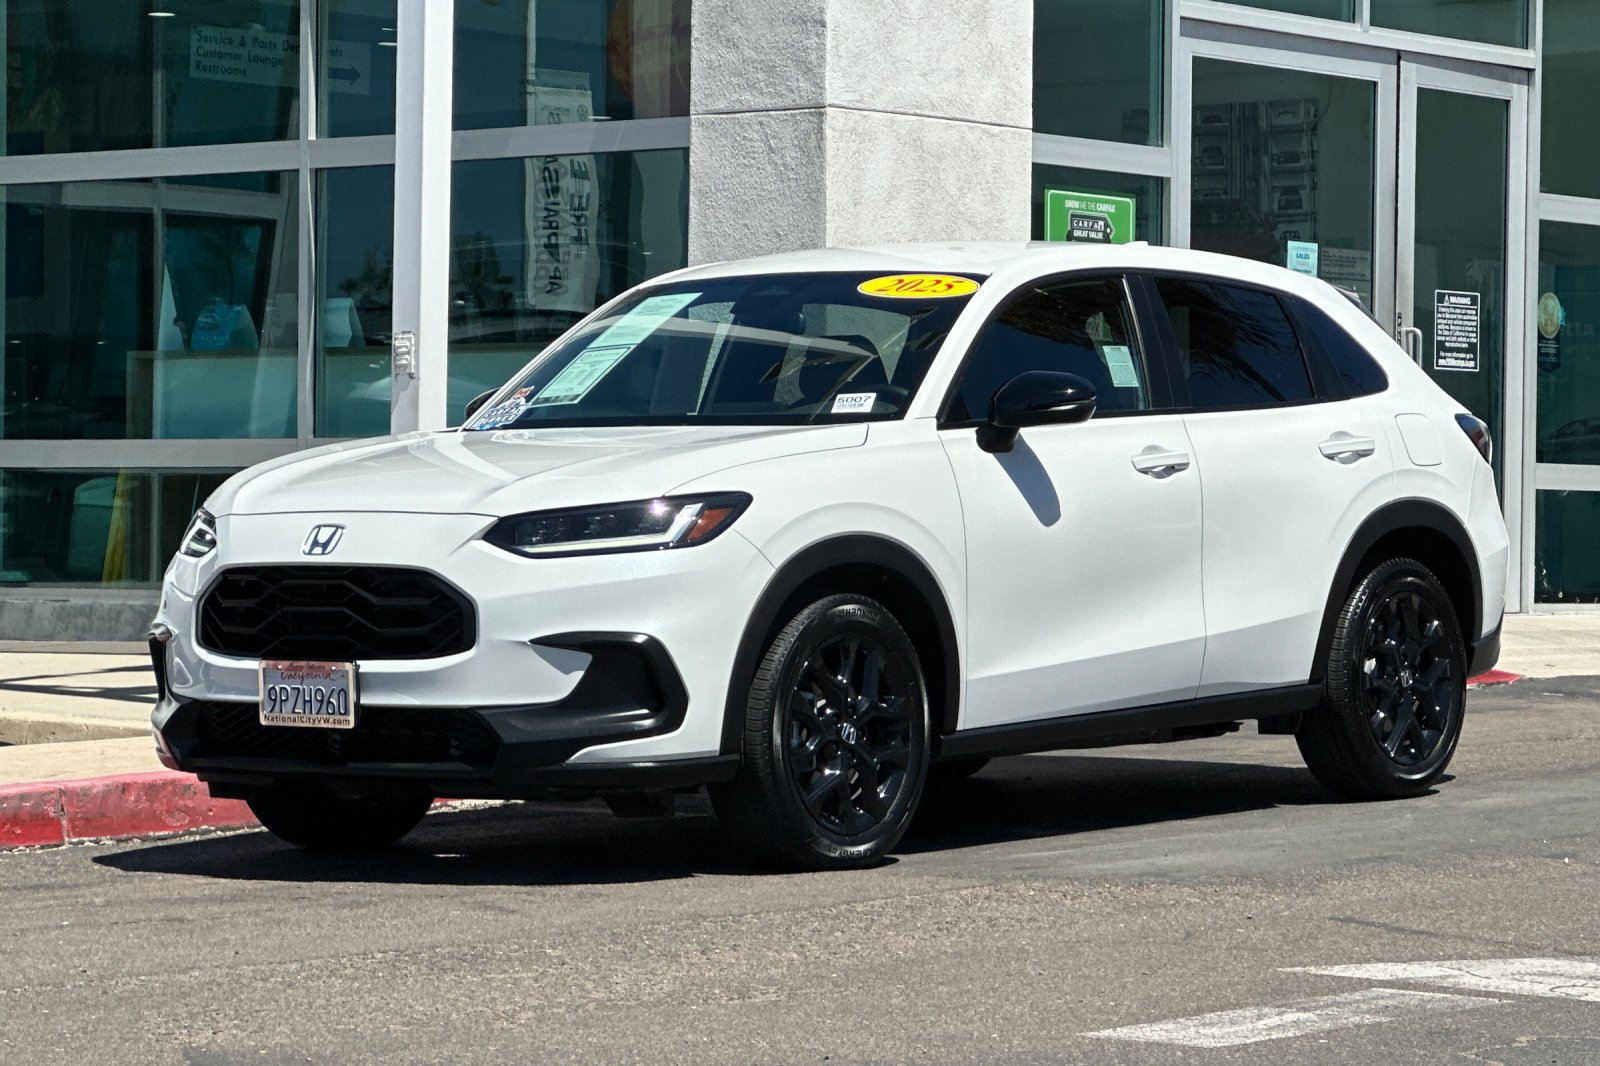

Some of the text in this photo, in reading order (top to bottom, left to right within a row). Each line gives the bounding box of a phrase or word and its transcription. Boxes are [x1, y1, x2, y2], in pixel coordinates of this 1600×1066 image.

[196, 30, 234, 46] Service
[239, 35, 246, 48] &
[252, 37, 277, 51] Parts
[196, 46, 284, 66] Customer Lounge
[196, 60, 247, 76] Restrooms
[1065, 200, 1079, 208] SHOW
[1088, 202, 1096, 210] THE
[1096, 203, 1116, 213] CARFAX
[1073, 220, 1105, 231] CARFAX
[1089, 231, 1104, 239] VALUE
[874, 278, 965, 293] 2025
[1450, 295, 1471, 305] WARNING
[837, 395, 872, 404] 5007
[280, 671, 332, 684] California
[268, 685, 348, 716] 9PZH960
[264, 714, 350, 726] NationalCityVW.com
